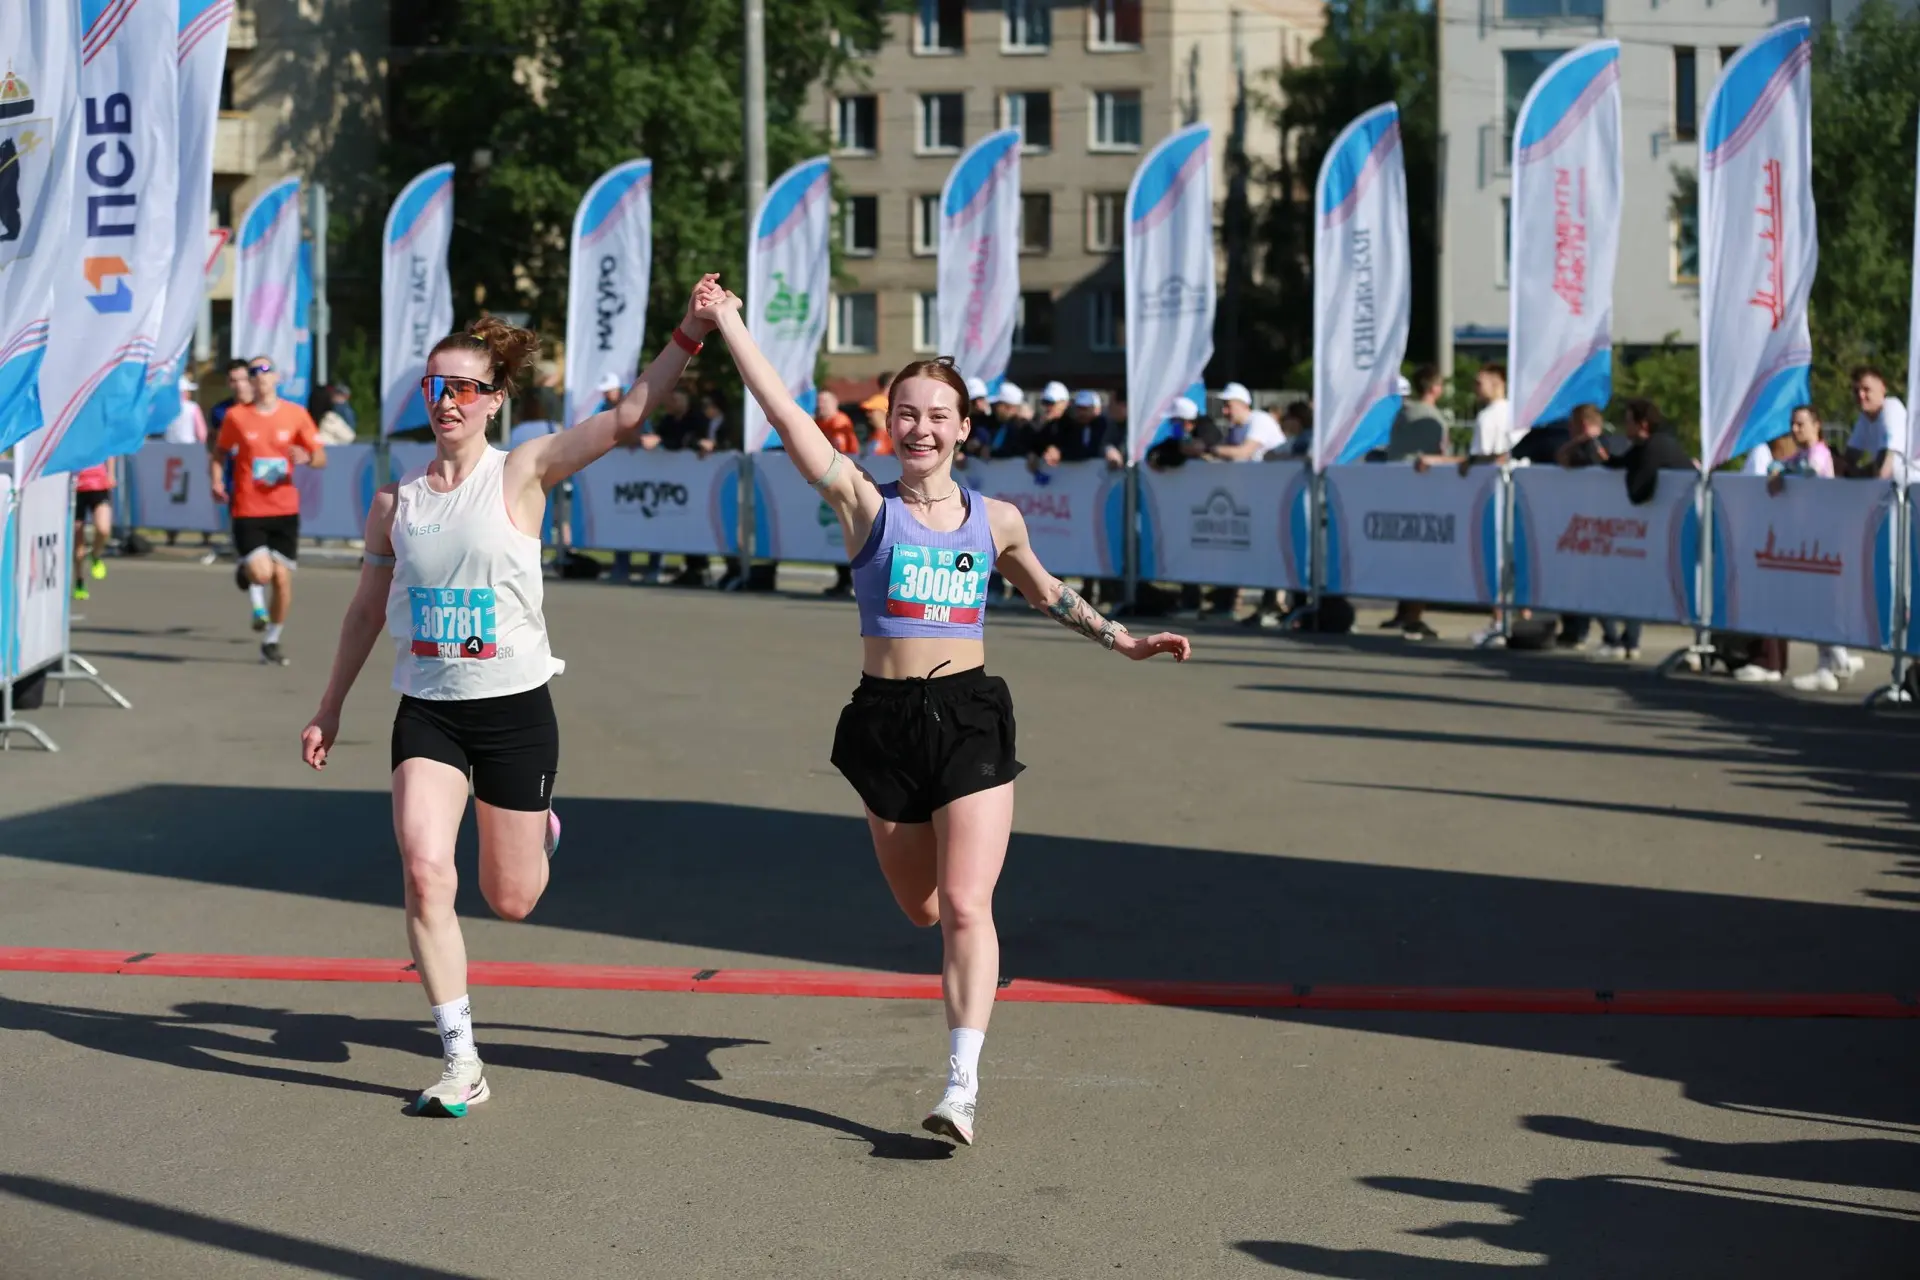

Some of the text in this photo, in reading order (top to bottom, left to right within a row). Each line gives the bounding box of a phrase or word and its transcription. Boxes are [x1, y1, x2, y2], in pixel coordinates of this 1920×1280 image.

[86, 92, 136, 238] ПСБ
[958, 556, 970, 569] A
[900, 563, 979, 605] 30083
[924, 603, 951, 622] 5KM
[421, 606, 482, 640] 30781
[437, 642, 461, 658] 5KM
[467, 639, 480, 652] A
